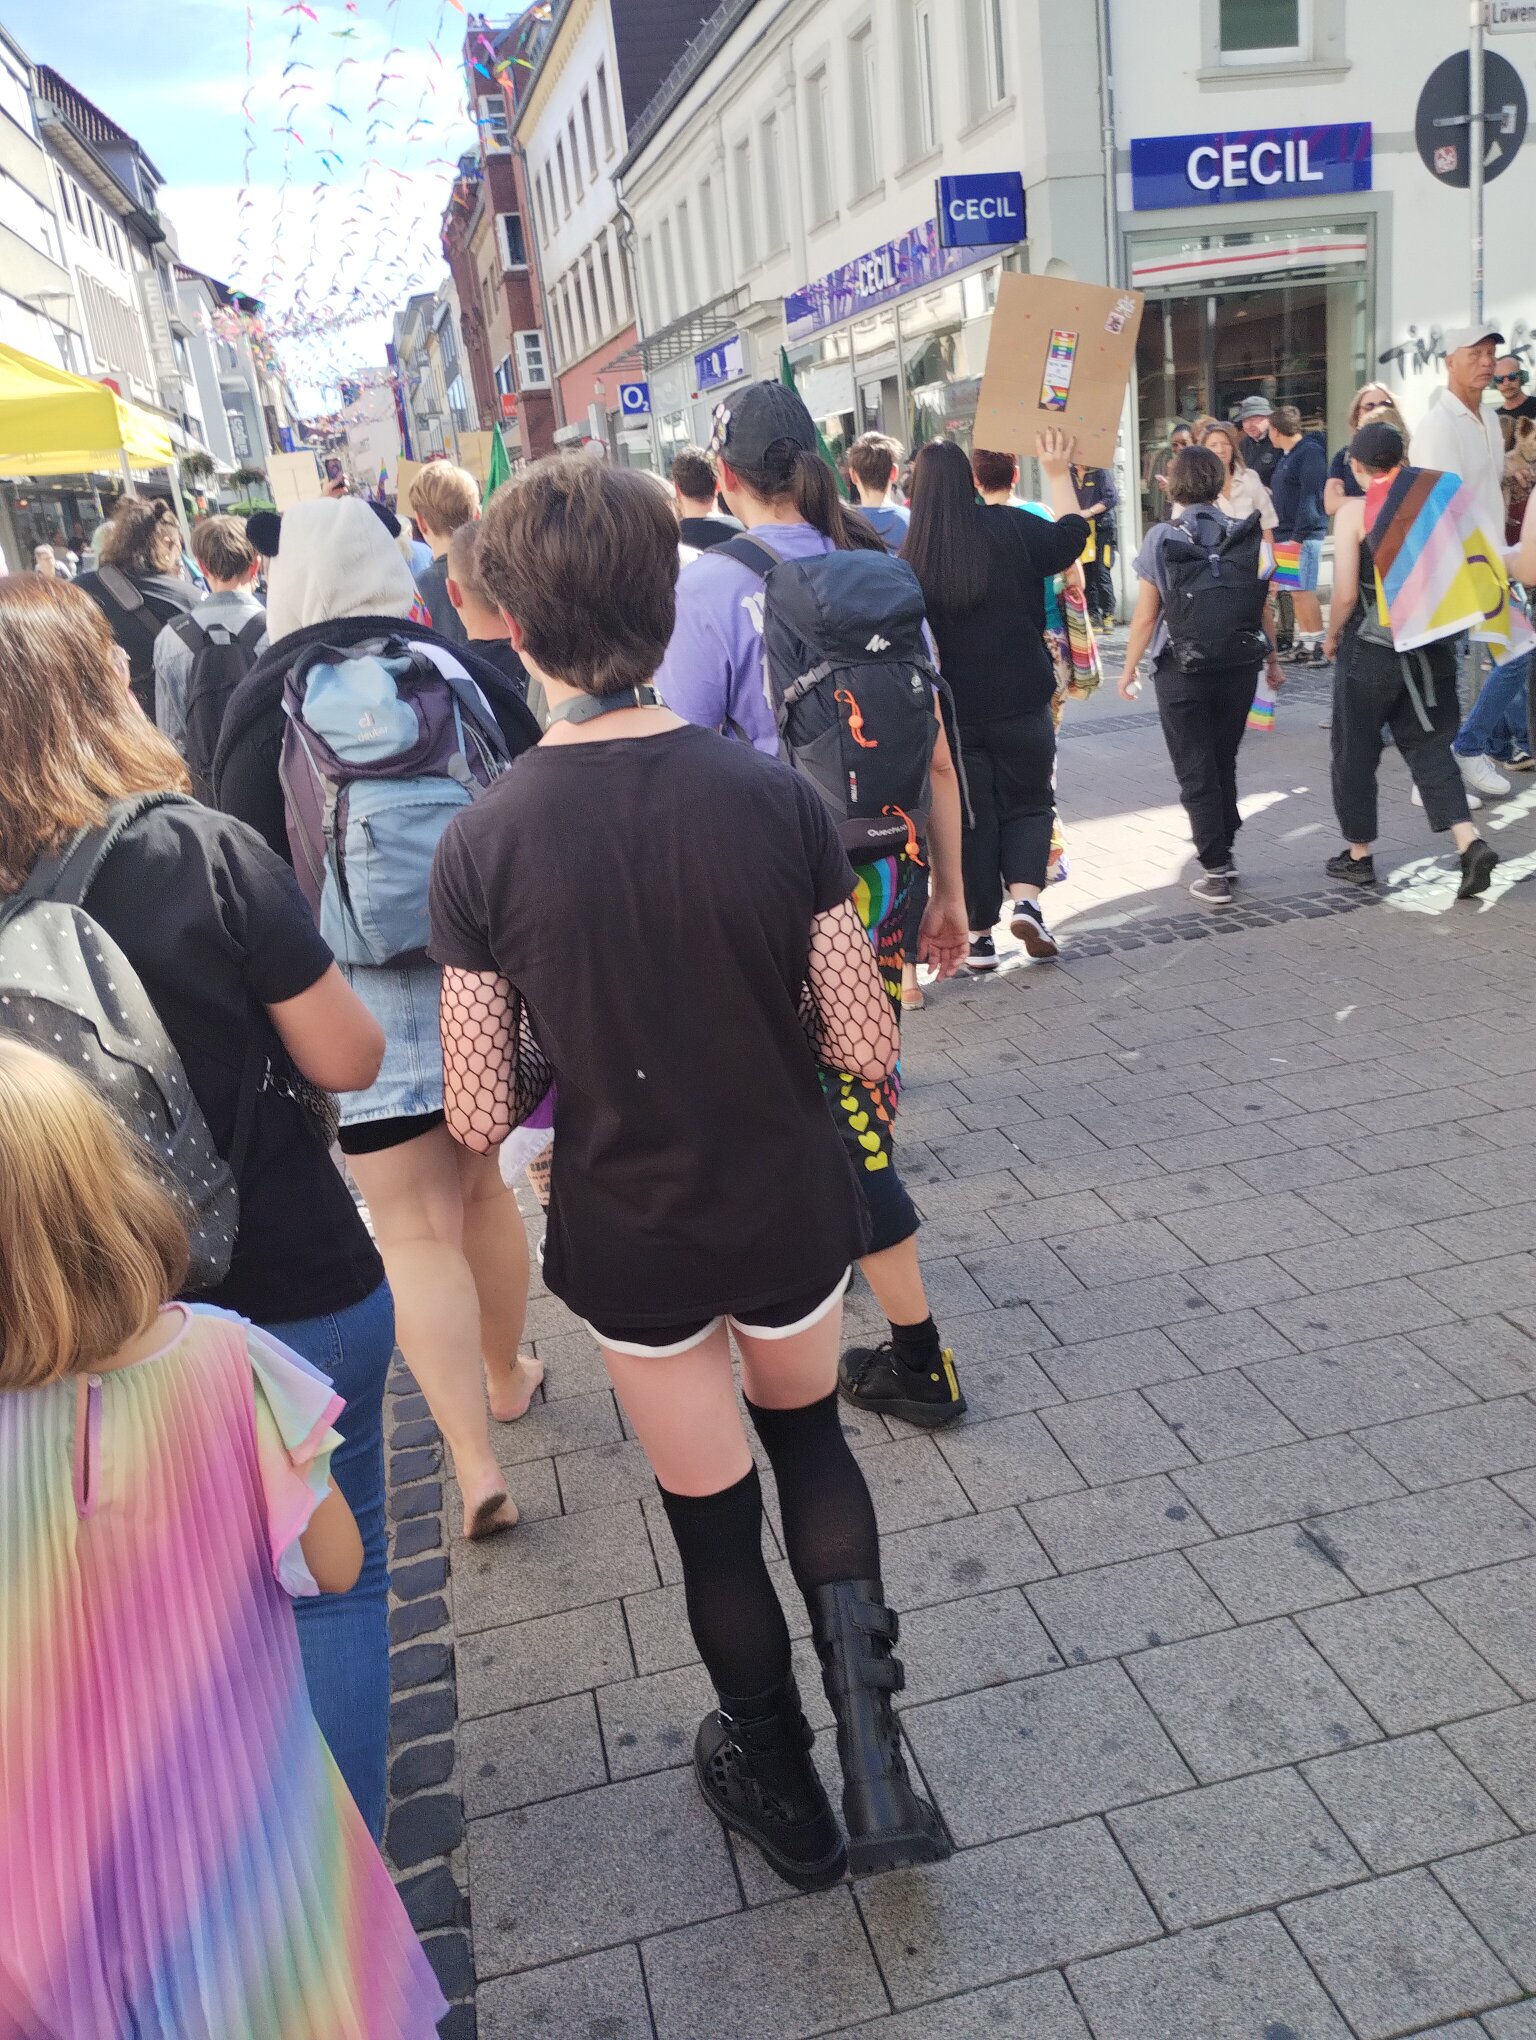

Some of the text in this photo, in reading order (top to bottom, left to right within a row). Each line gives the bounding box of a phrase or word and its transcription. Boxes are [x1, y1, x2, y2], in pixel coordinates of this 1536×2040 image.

[1187, 139, 1324, 190] CECIL
[949, 196, 1017, 221] CECIL
[859, 252, 897, 297] CECIL
